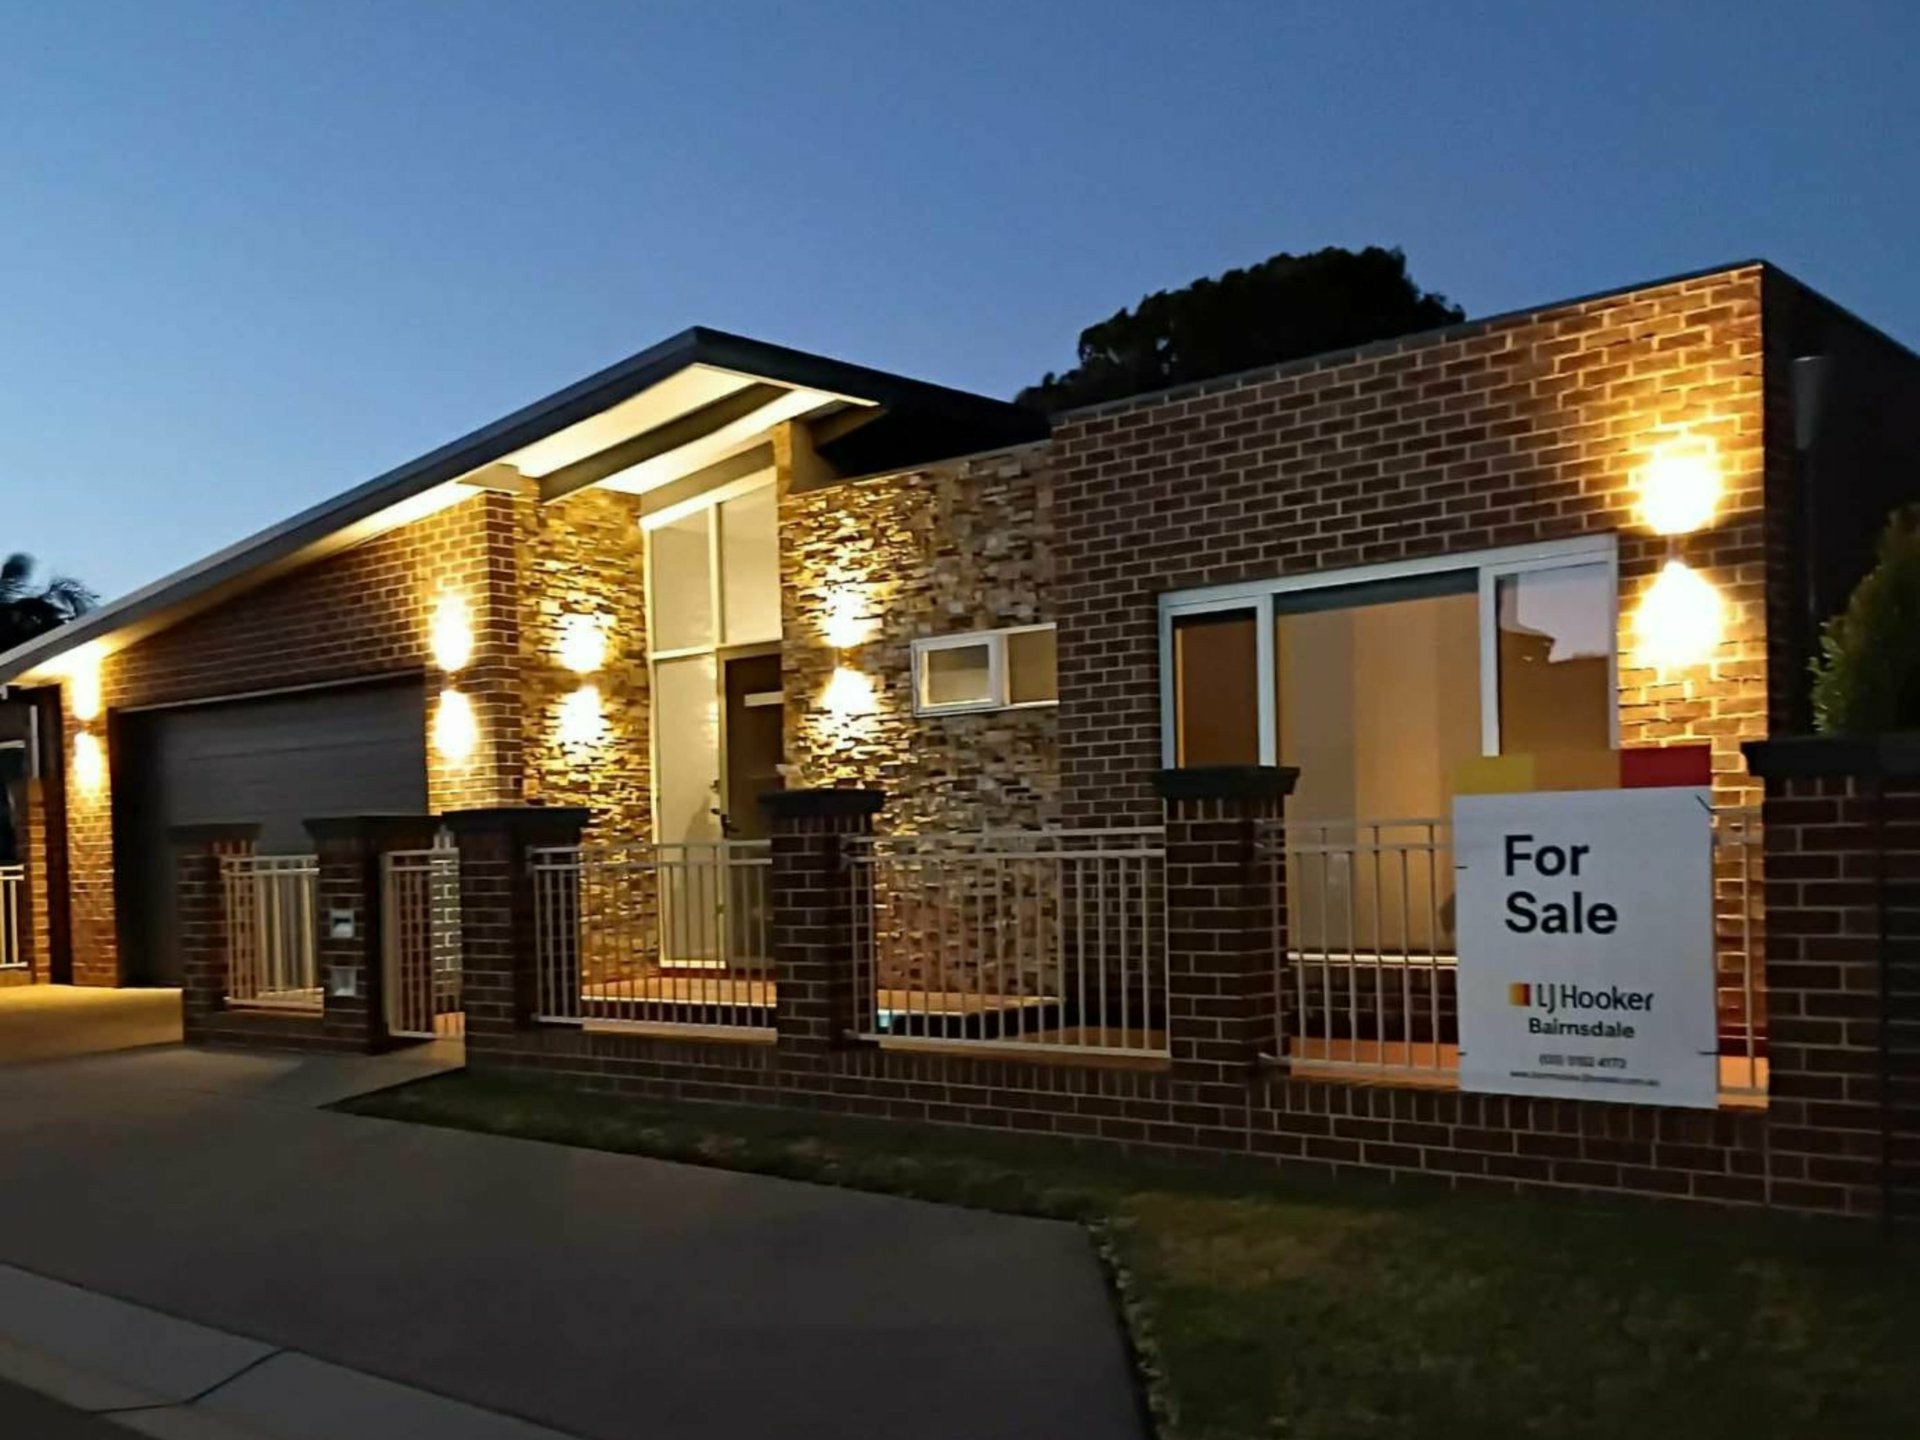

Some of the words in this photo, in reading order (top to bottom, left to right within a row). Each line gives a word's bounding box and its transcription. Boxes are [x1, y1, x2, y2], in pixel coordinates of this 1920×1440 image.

[1504, 834, 1590, 877] For
[1504, 890, 1619, 935] Sale
[1560, 983, 1655, 1012] Hooker
[1528, 1017, 1635, 1039] Bairnsdale
